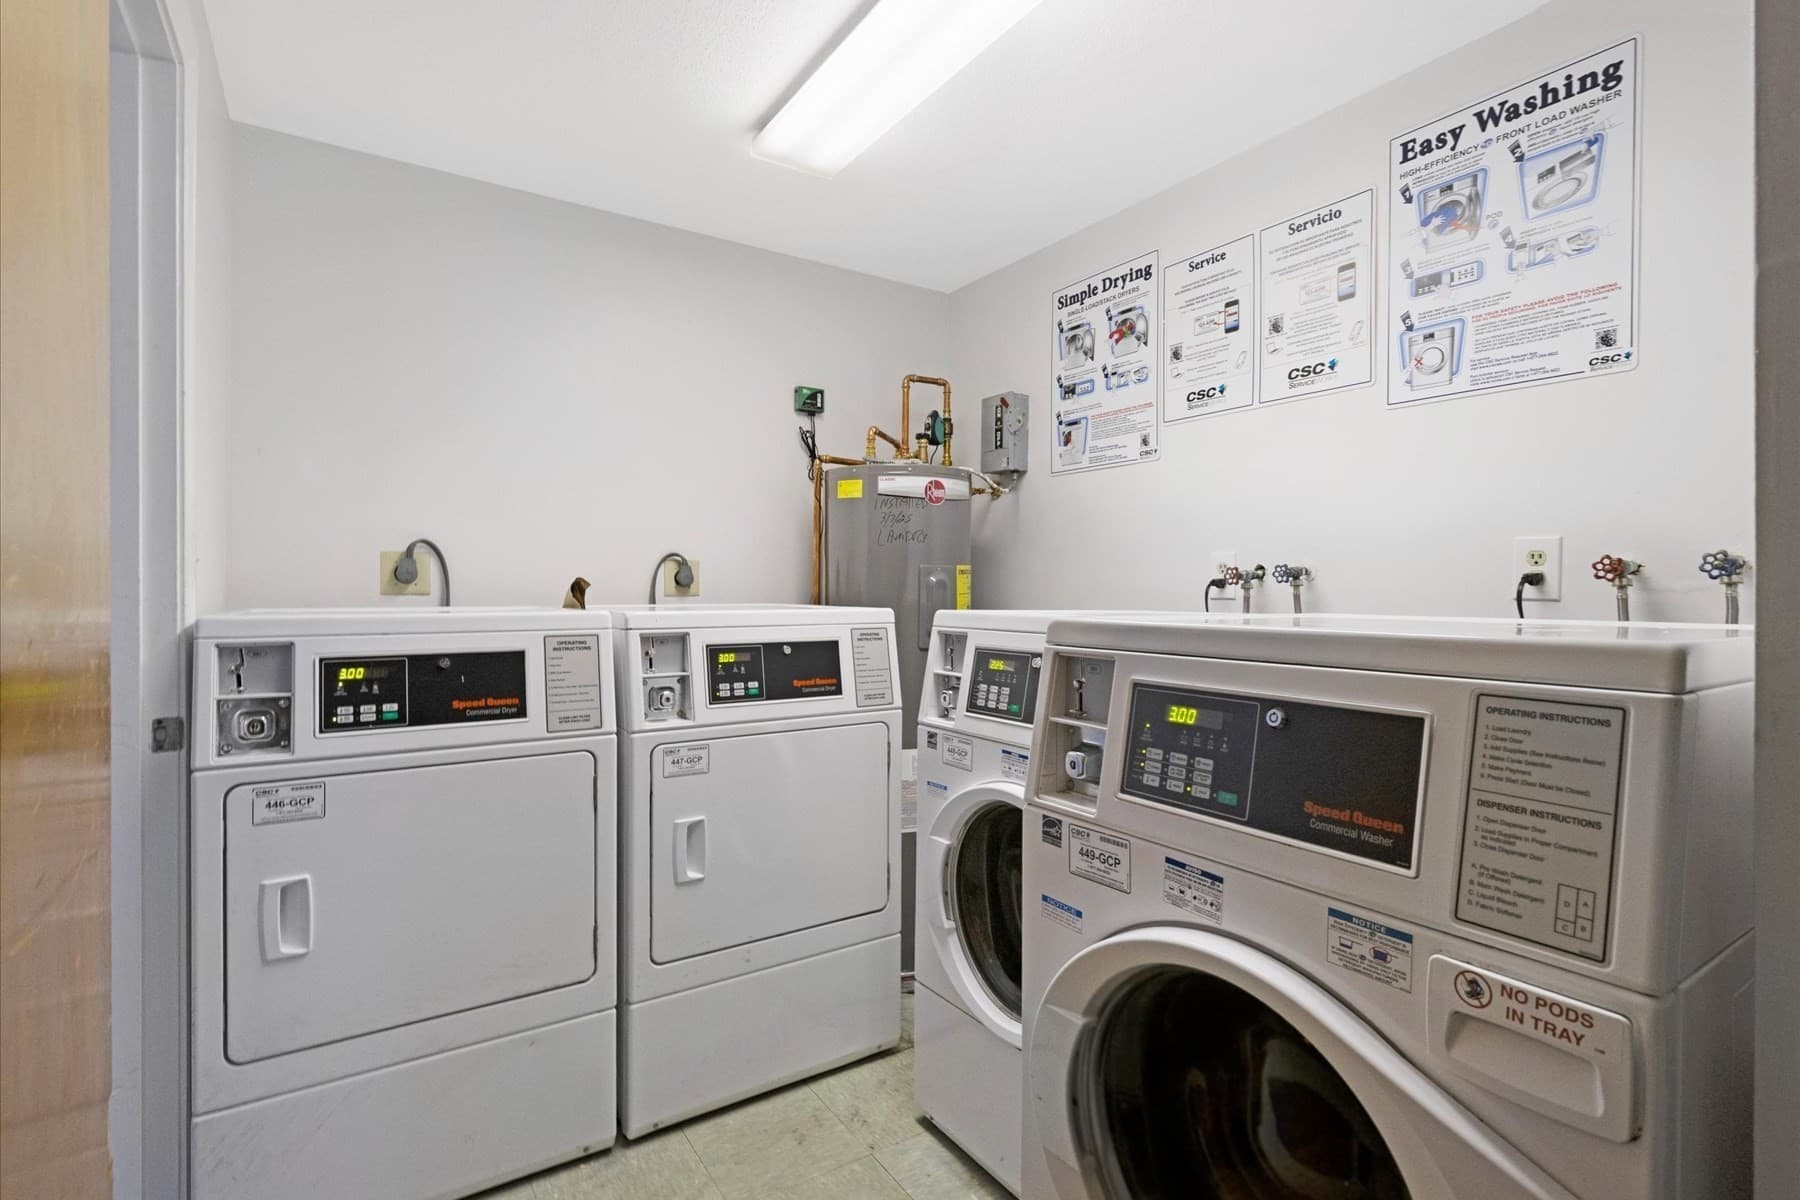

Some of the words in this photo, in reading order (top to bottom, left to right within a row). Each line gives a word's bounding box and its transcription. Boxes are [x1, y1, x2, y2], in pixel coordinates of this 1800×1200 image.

[1400, 124, 1466, 164] Easy
[1473, 60, 1624, 133] Washing
[1400, 144, 1480, 180] HIGH-EFFICIENCY
[1496, 124, 1532, 144] FRONT
[1535, 110, 1566, 129] LOAD
[1570, 89, 1623, 116] WASHER
[1288, 208, 1342, 236] Servicio
[1188, 252, 1226, 272] Service
[1057, 283, 1098, 310] Simple
[1102, 264, 1153, 292] Drying
[1118, 286, 1140, 300] DRYERS
[1288, 362, 1326, 380] CSC
[1589, 354, 1622, 367] CSC
[1186, 388, 1216, 402] CSC
[451, 698, 486, 711] Speed
[487, 696, 520, 707] Queen
[466, 708, 500, 717] Commercial
[502, 706, 518, 716] Dryer
[1168, 704, 1197, 727] 3.00
[1486, 706, 1537, 720] OPERATING
[1539, 710, 1612, 728] INSTRUCTIONS
[671, 756, 702, 765] 447-GCP
[265, 797, 314, 809] 446-GCP
[1304, 800, 1350, 822] Speed
[1352, 811, 1404, 834] Queen
[1476, 799, 1528, 817] DISPENSER
[1529, 809, 1602, 831] INSTRUCTIONS
[1482, 816, 1498, 826] Open
[1500, 819, 1530, 832] Dispenser
[1310, 818, 1358, 839] Commercial
[1360, 830, 1394, 848] Washer
[1078, 847, 1121, 868] 449-GCP
[1498, 847, 1528, 860] Dispenser
[1531, 838, 1552, 849] Proper
[1554, 842, 1598, 860] Compartment
[1352, 916, 1387, 934] NOTICE
[1500, 984, 1528, 1006] NO
[1535, 996, 1594, 1030] PODS
[1506, 1006, 1524, 1025] IN
[1531, 1016, 1586, 1047] TRAY
